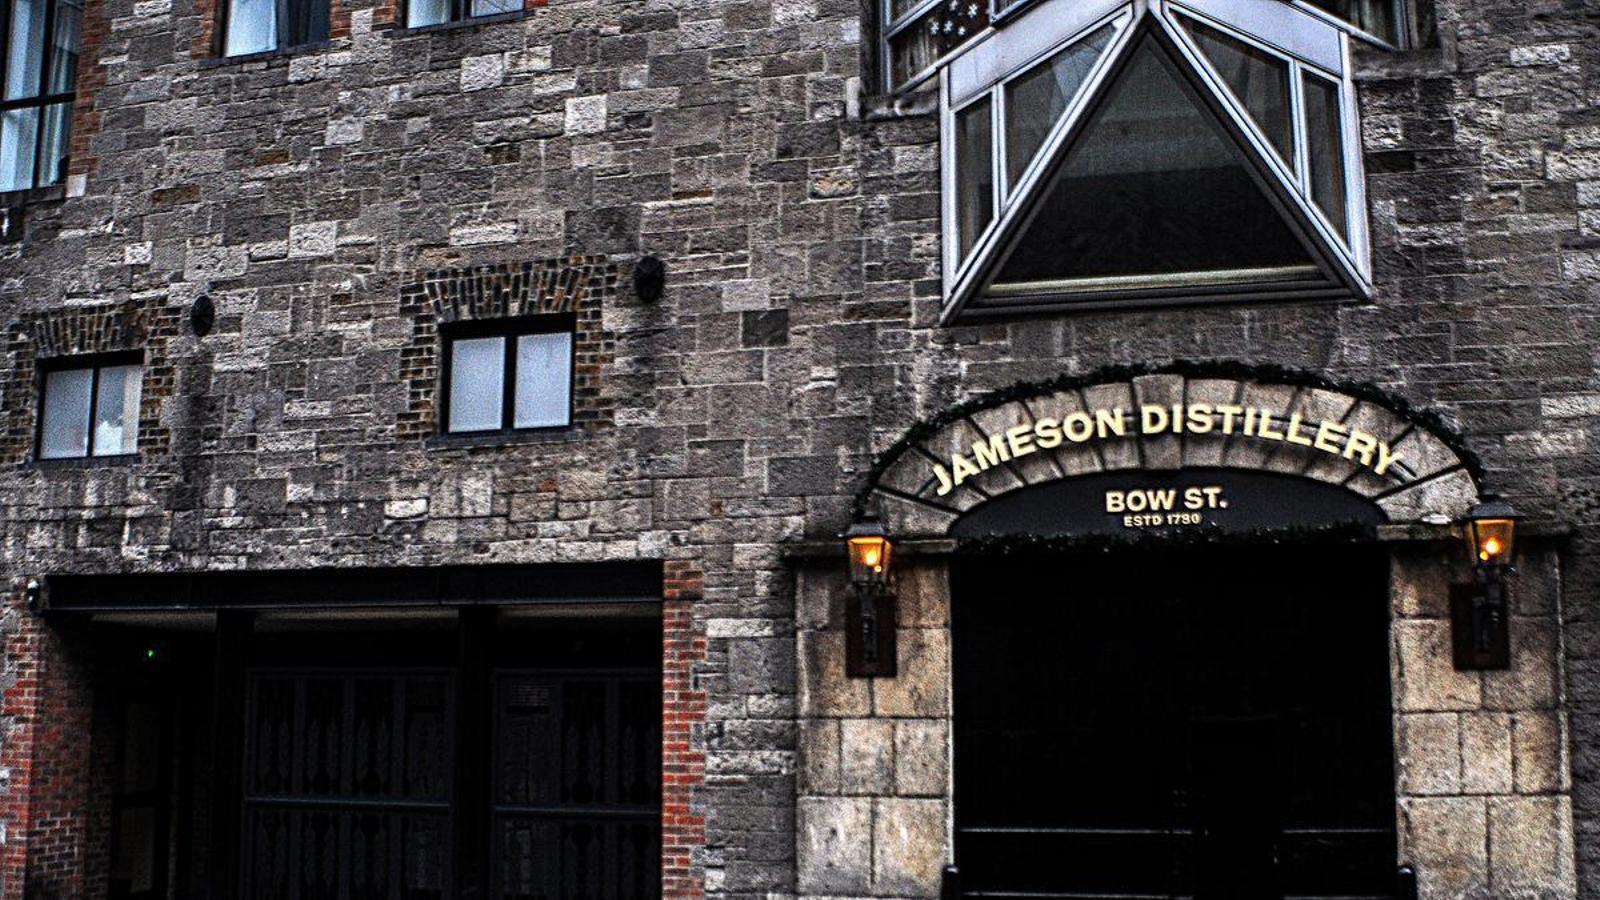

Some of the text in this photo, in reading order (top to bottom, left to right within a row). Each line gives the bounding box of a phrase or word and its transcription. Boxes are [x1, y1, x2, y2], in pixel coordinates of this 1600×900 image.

[932, 403, 1400, 497] JAMESON DISTILLERY
[1105, 487, 1228, 512] BOW ST.
[1123, 513, 1202, 527] ESTD 1780
